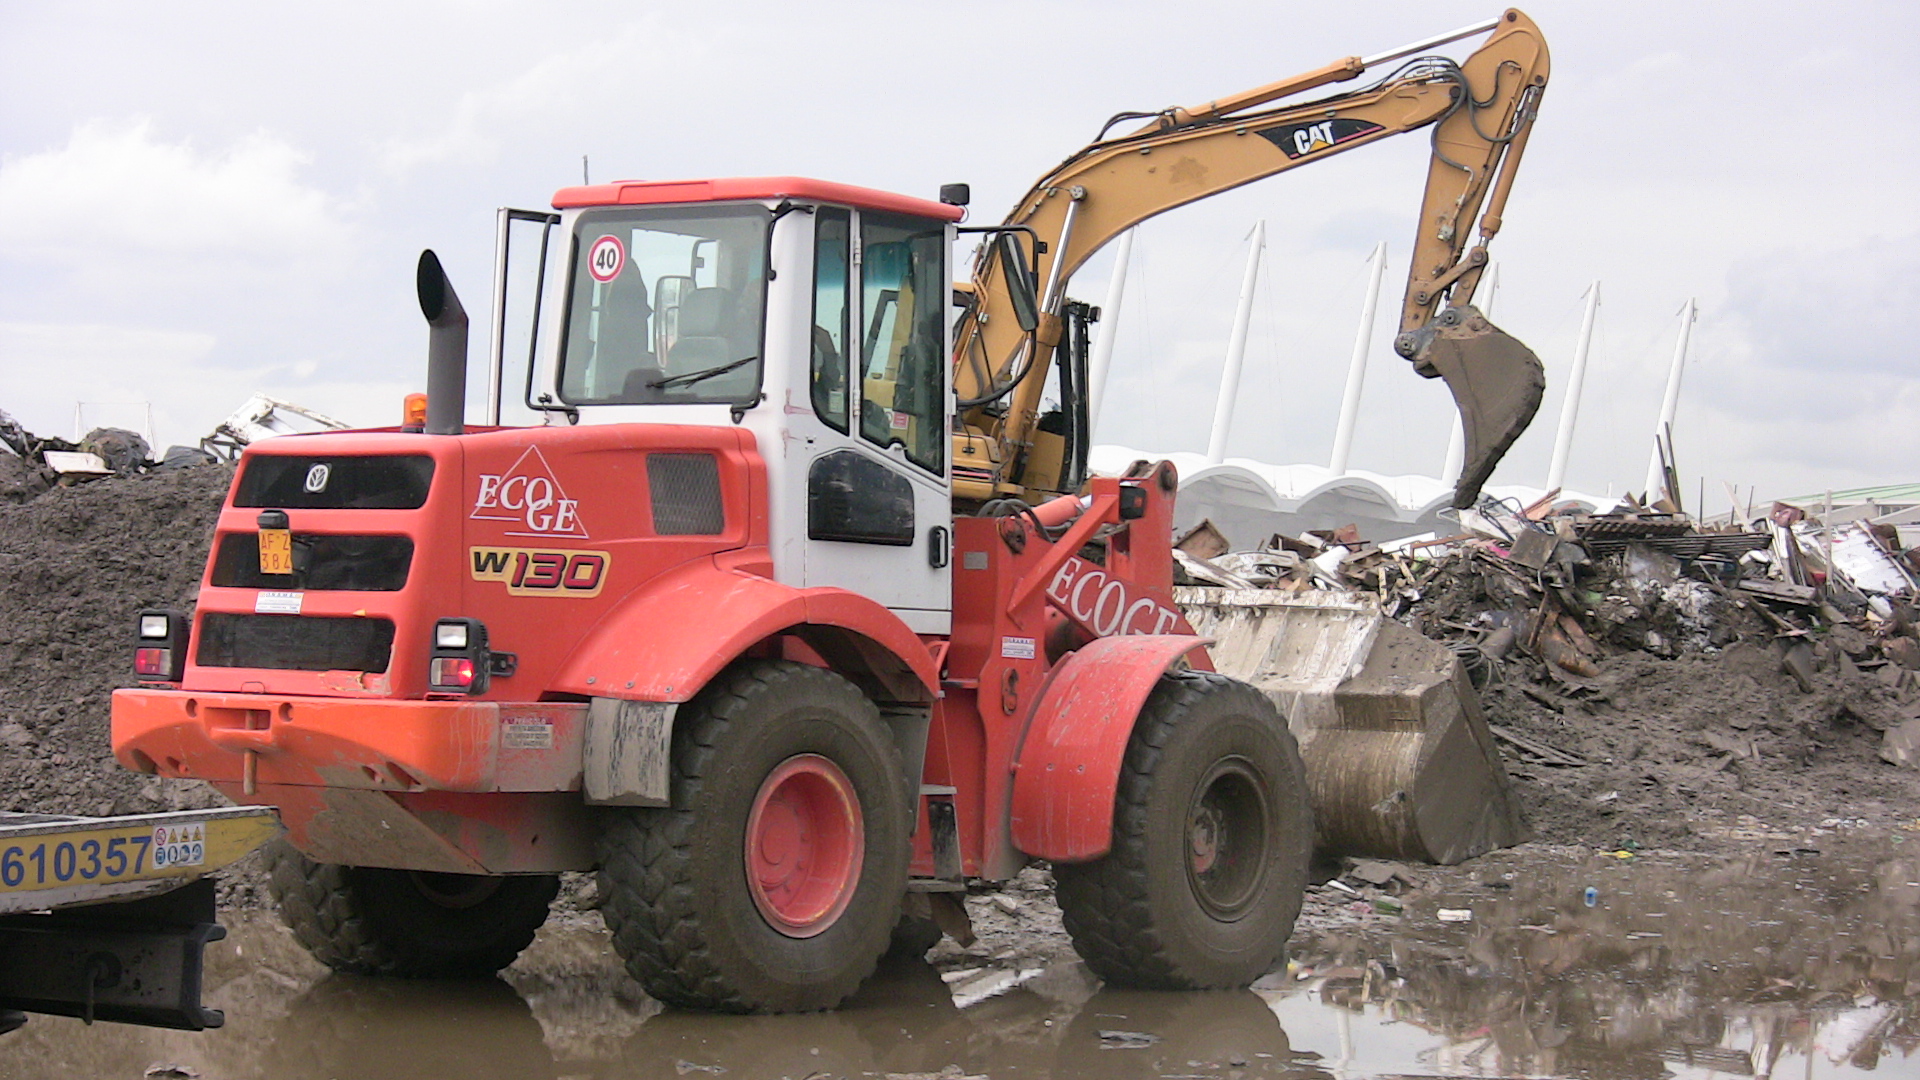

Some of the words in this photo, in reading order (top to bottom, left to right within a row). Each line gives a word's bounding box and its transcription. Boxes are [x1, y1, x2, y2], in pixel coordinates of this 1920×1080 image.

[1293, 121, 1335, 155] CAT
[596, 248, 616, 270] 40
[261, 553, 291, 570] 384
[473, 551, 604, 590] W130
[1, 835, 151, 888] 610357
